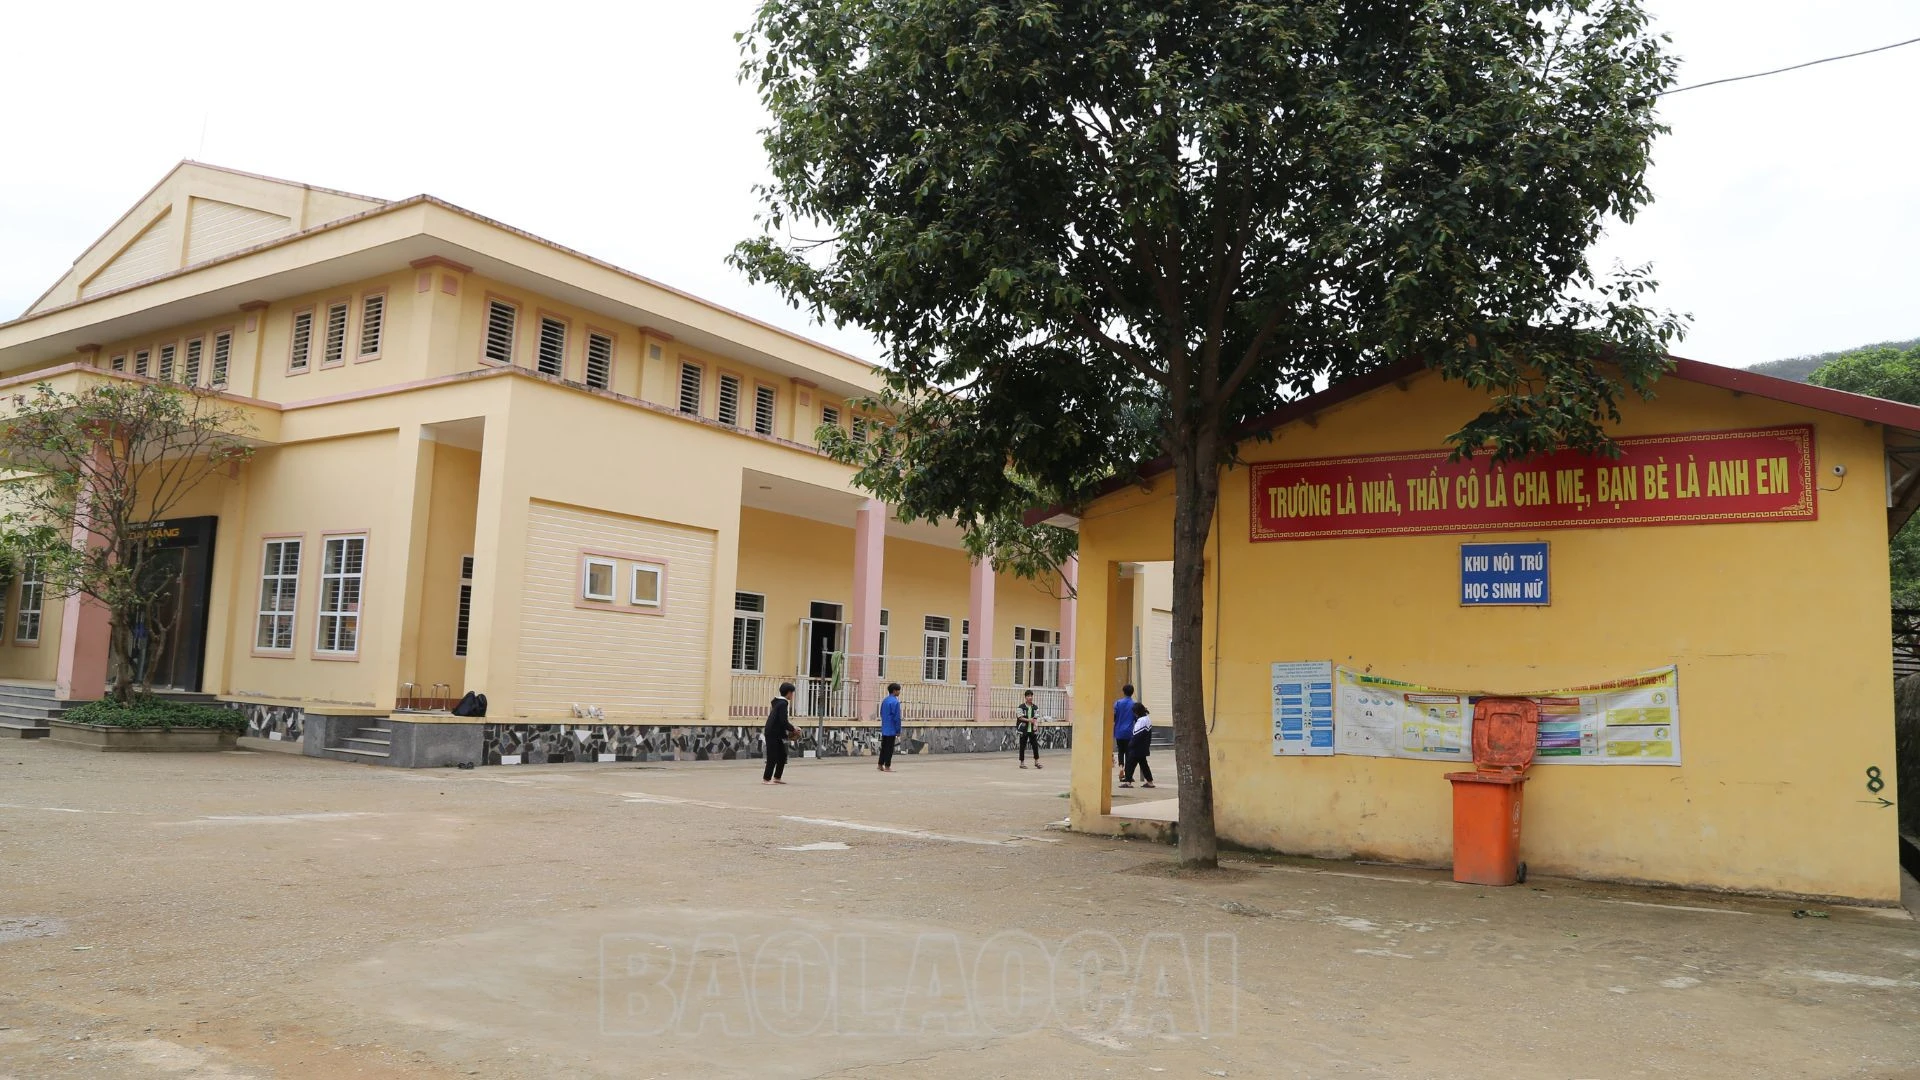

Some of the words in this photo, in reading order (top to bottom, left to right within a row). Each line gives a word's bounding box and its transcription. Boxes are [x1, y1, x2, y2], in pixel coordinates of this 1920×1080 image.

[1268, 478, 1331, 518] TRƯỜNG
[1336, 475, 1357, 516] LÀ
[1362, 473, 1402, 516] NHÀ,
[1407, 466, 1450, 512] THẦY
[1455, 468, 1479, 509] CÔ
[1485, 466, 1508, 508] LÀ
[1513, 470, 1550, 506] CHA
[1556, 468, 1591, 511] MẸ,
[1597, 465, 1637, 510] BẠN
[1644, 457, 1669, 500] BÈ
[1675, 455, 1700, 498] LÀ
[1707, 459, 1749, 497] ANH
[1756, 457, 1789, 495] EM
[1464, 555, 1489, 572] KHU
[1493, 552, 1514, 574] NỘI
[1520, 551, 1543, 571] TRÚ
[1464, 583, 1489, 602] HỌC
[1492, 582, 1521, 599] SINH
[1524, 578, 1544, 599] NỮ
[1866, 766, 1884, 793] 8
